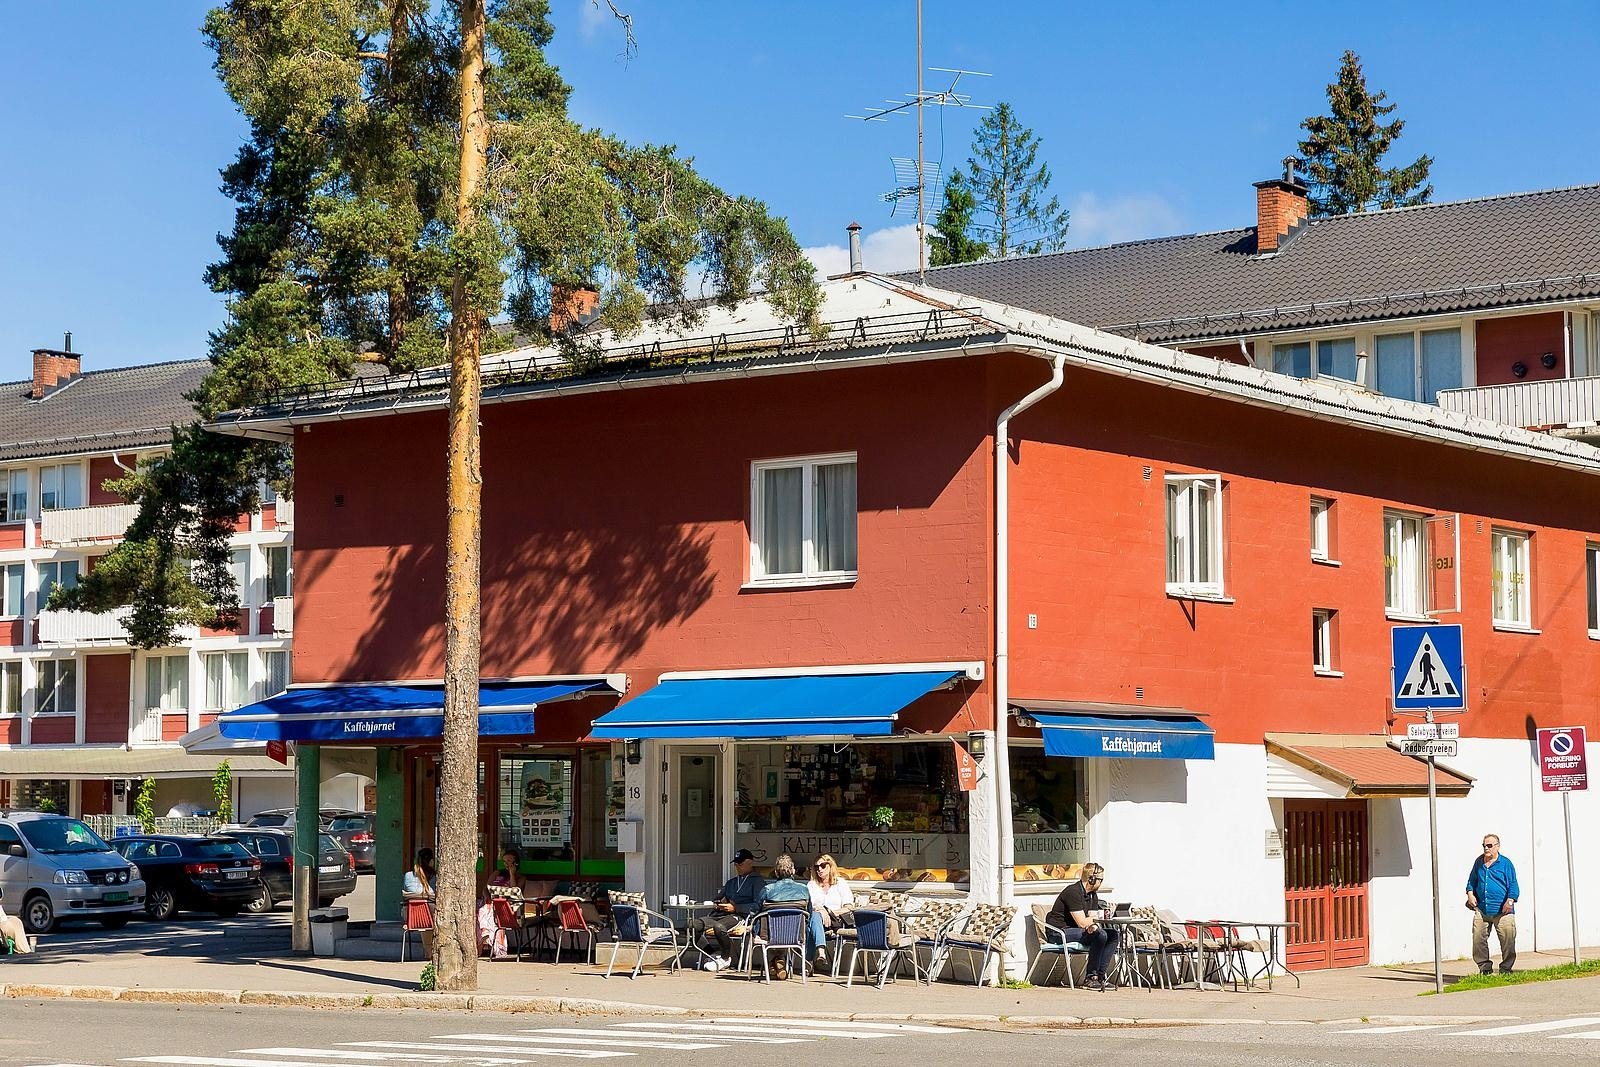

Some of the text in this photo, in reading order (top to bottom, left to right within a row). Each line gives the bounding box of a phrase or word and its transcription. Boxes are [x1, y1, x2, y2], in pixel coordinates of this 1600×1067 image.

[343, 721, 396, 734] Kaffehjørnet
[1101, 736, 1162, 755] Kaffehjørnet
[1404, 743, 1453, 755] Rødbergveien
[1544, 755, 1582, 763] PARKERING
[1547, 762, 1579, 770] FORBUDT
[628, 786, 641, 799] 18
[782, 836, 924, 858] KAFFEHJØRNET
